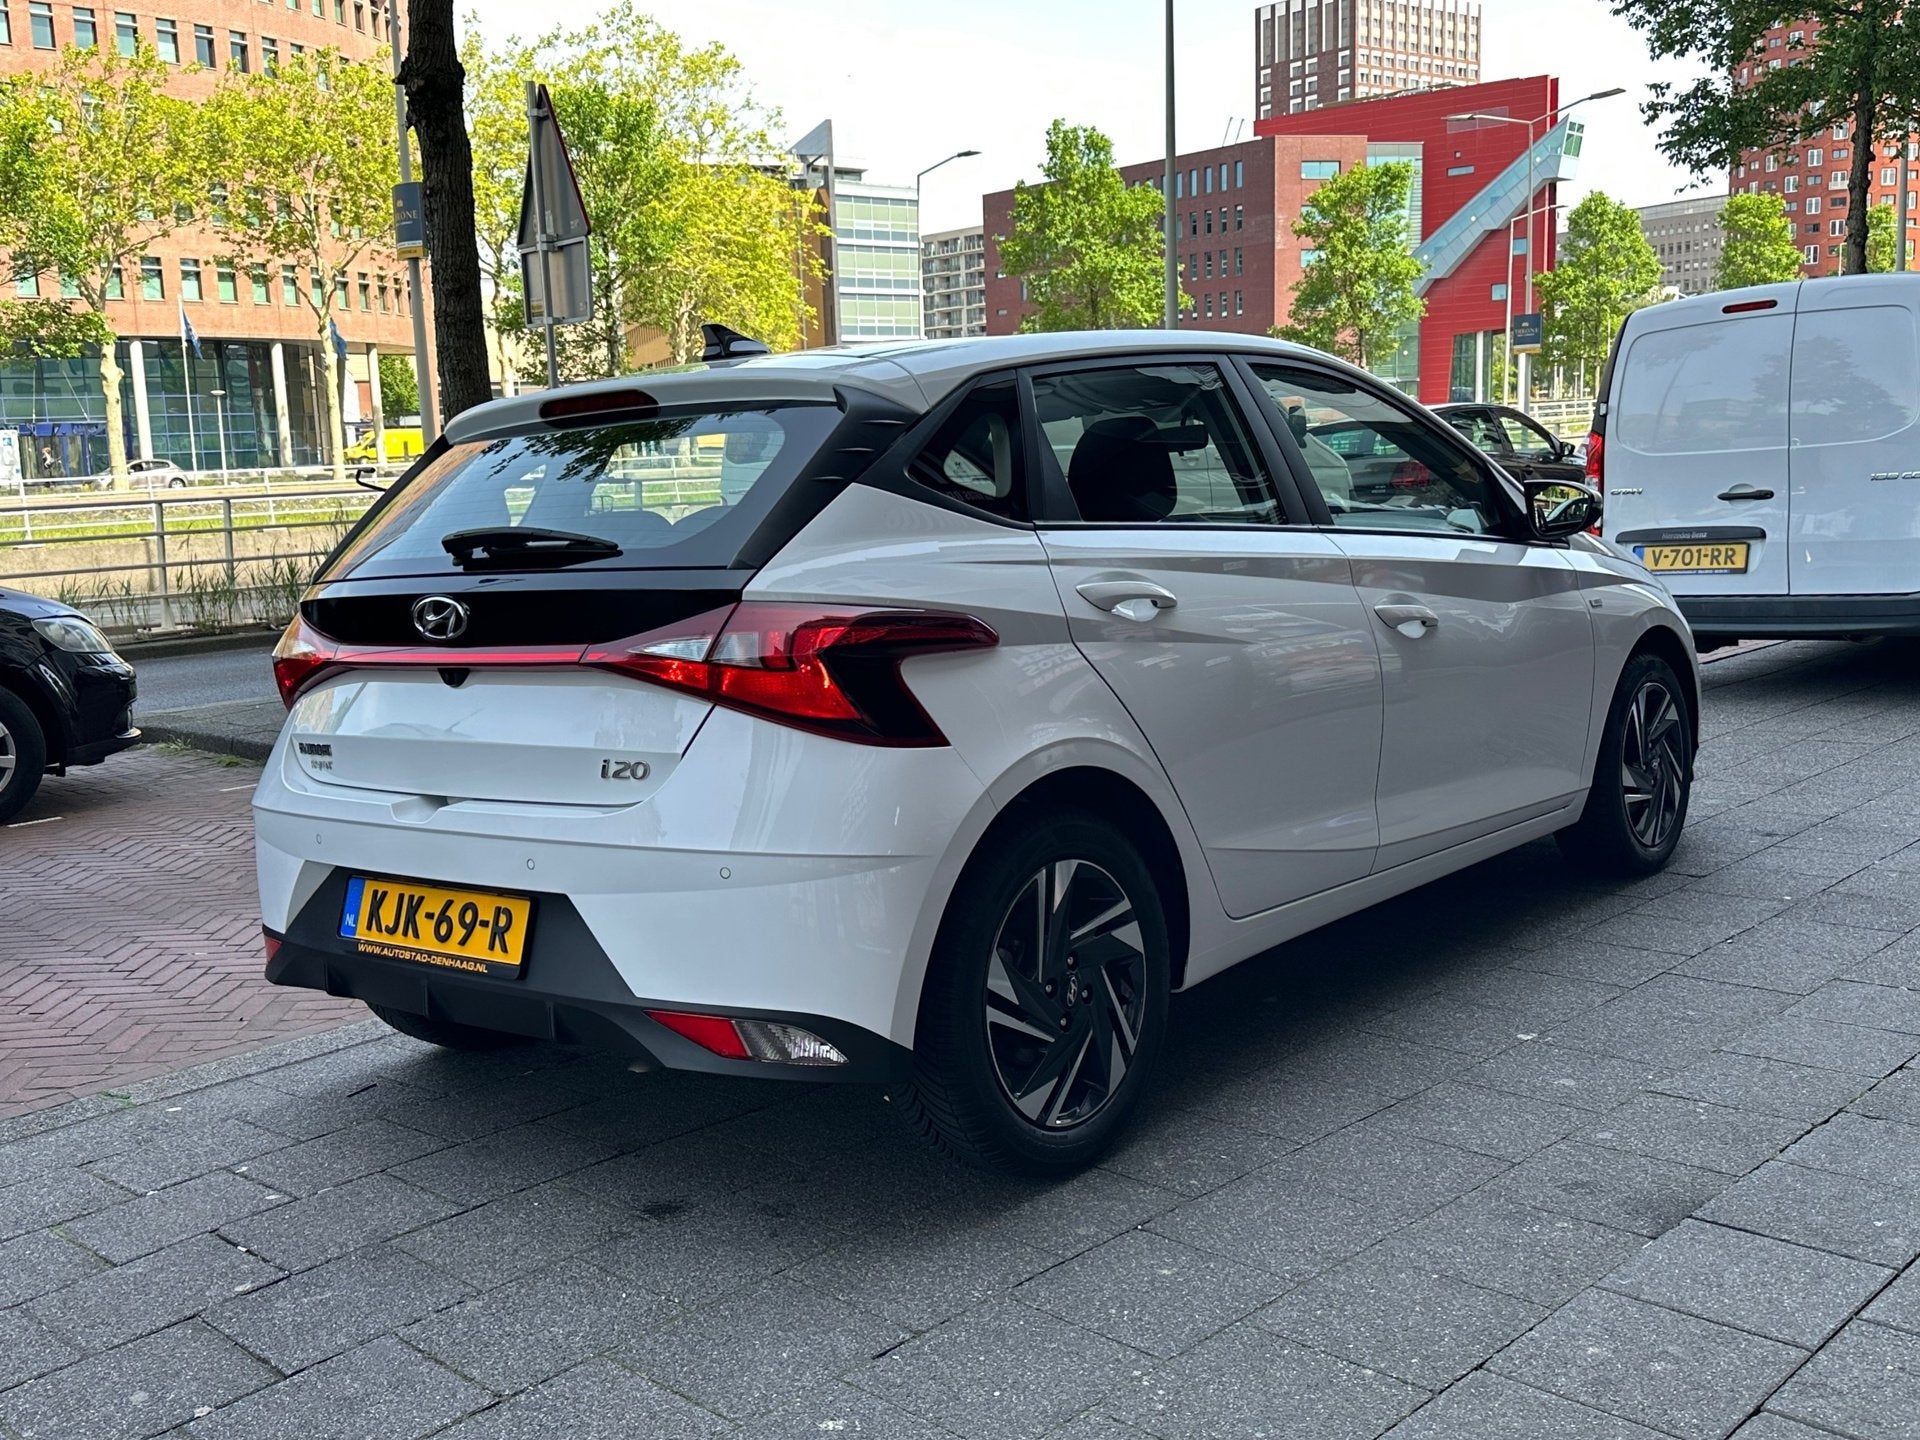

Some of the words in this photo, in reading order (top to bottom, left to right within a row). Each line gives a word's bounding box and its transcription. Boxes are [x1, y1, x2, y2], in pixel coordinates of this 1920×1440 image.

[1651, 547, 1736, 567] V-701-RR
[601, 759, 651, 780] i20
[345, 912, 356, 928] NL
[366, 889, 513, 954] KJK-69-R
[358, 943, 488, 973] WWW.AUTOSTAD-DENHAAG.NL
